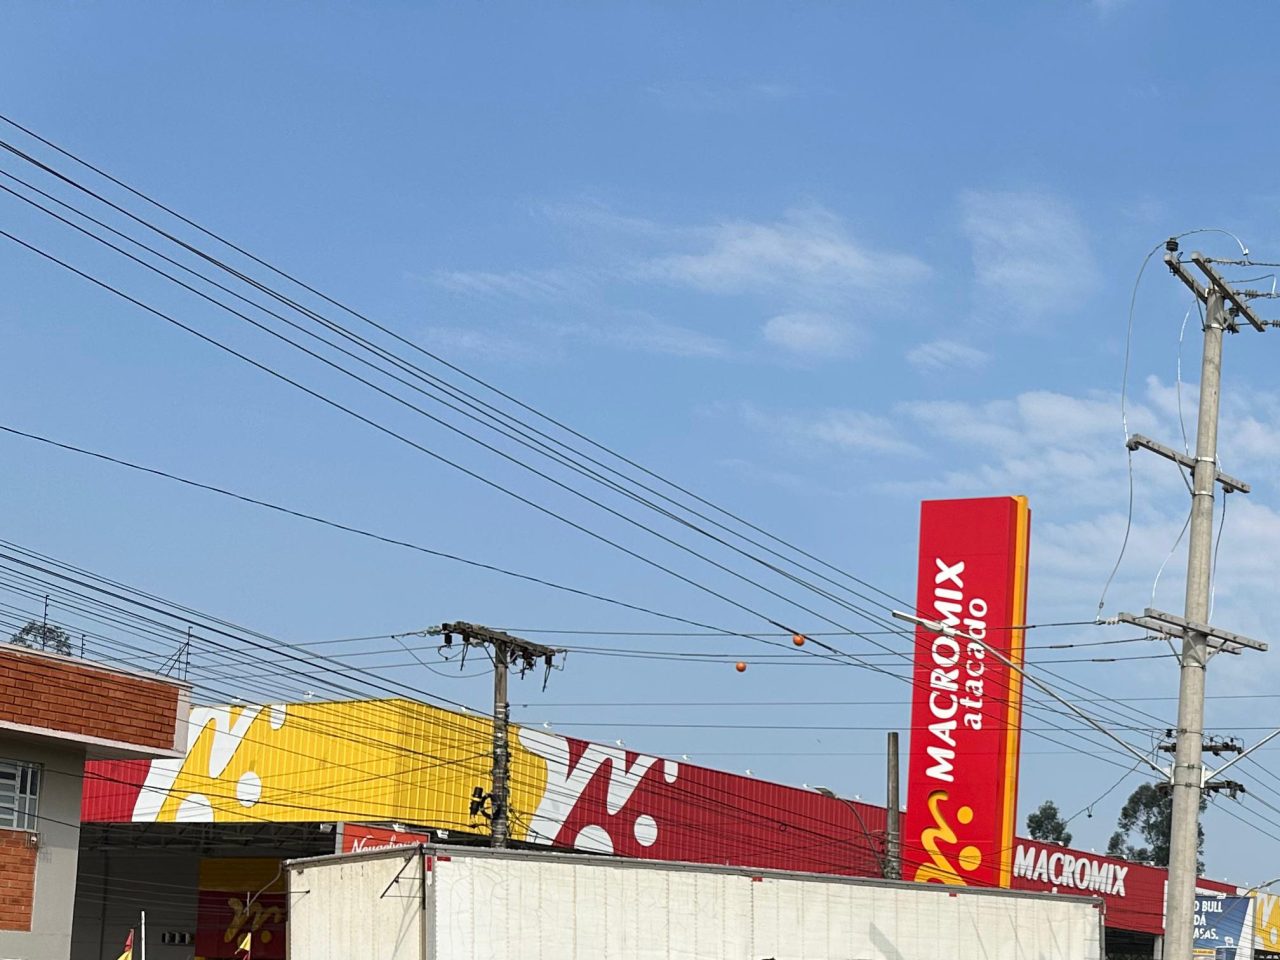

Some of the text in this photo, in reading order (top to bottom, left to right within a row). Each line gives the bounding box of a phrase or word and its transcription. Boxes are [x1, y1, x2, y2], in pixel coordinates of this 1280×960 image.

[925, 557, 965, 783] MACROMIX
[959, 598, 988, 730] atacado
[1013, 844, 1129, 897] MACROMIX
[1193, 912, 1207, 926] DÁ
[1202, 901, 1223, 912] BULL
[1193, 928, 1219, 940] ASAS.
